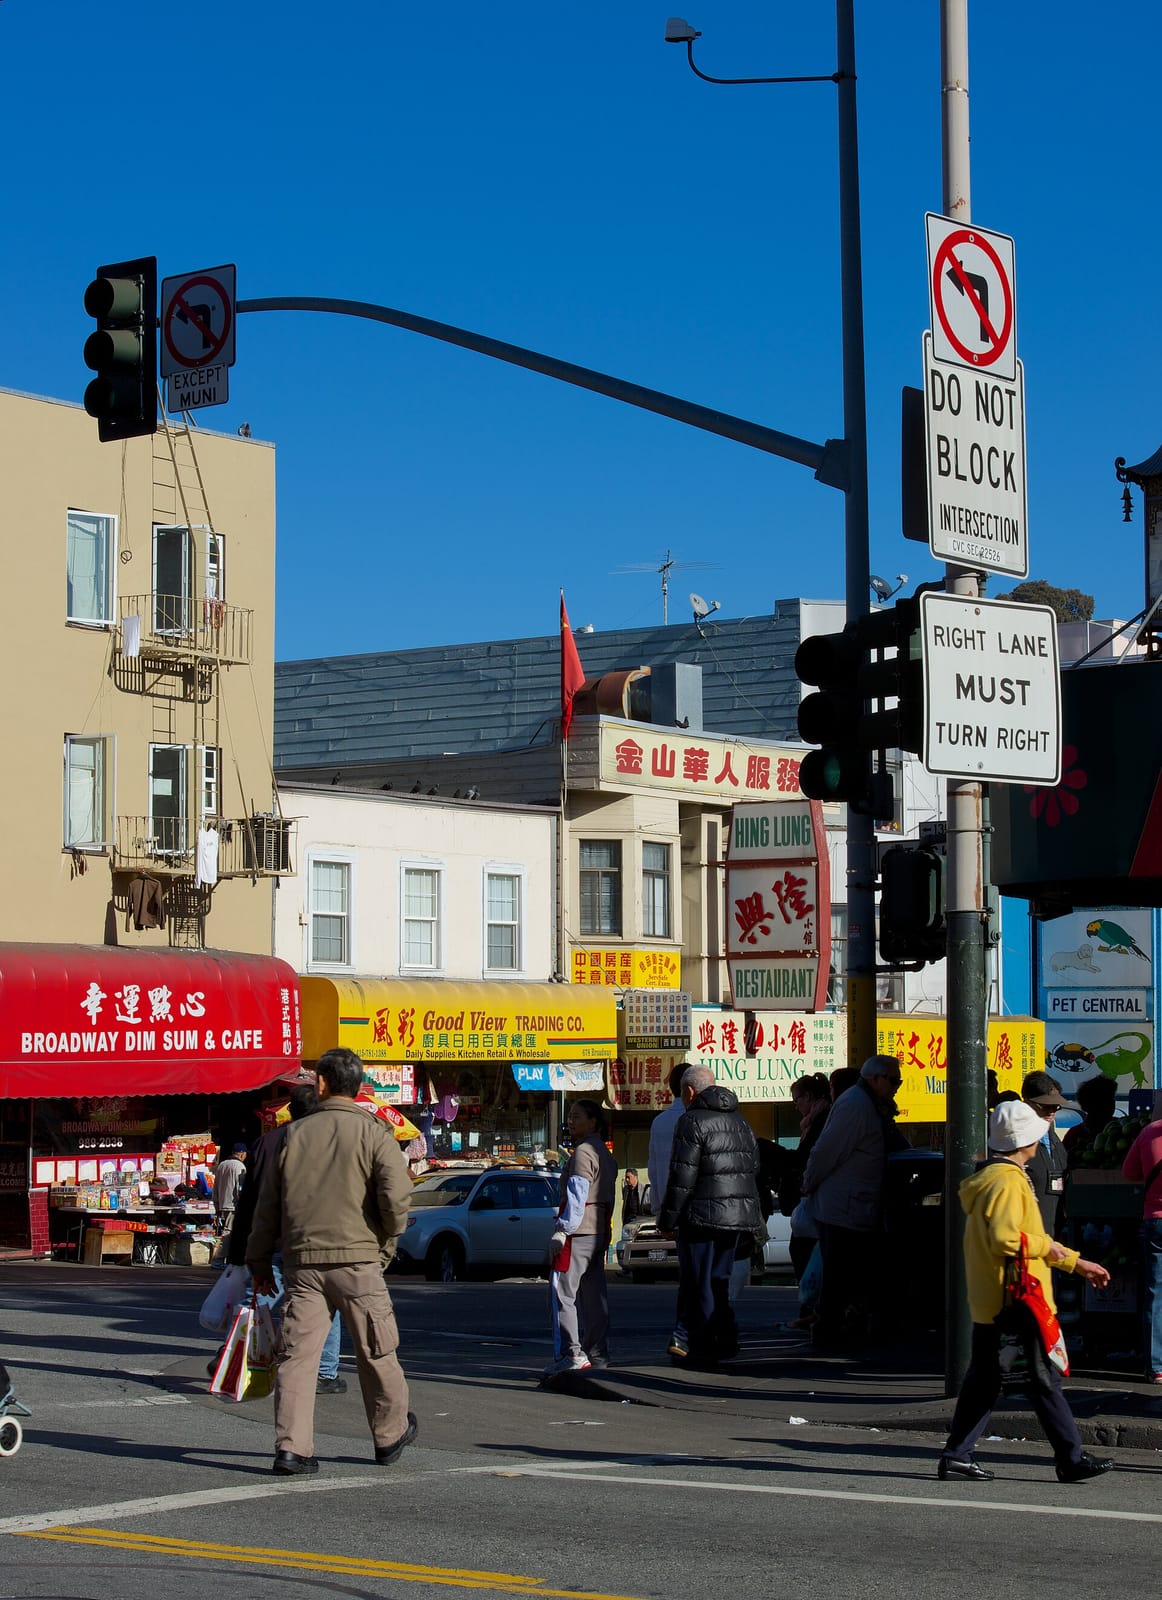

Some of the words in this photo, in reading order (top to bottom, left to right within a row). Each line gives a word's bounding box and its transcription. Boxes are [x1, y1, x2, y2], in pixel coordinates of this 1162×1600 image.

[173, 367, 222, 390] EXCEPT
[180, 387, 216, 408] MUNI
[931, 369, 962, 416] DO
[975, 380, 1016, 430] NOT
[936, 434, 1017, 493] BLOCK
[940, 503, 1019, 546] INTERSECTION
[952, 539, 965, 553] CVC
[933, 625, 986, 651] RIGHT
[998, 632, 1048, 657] LANE
[956, 673, 1031, 706] MUST
[935, 722, 987, 748] TURN
[997, 727, 1050, 753] RIGHT
[615, 738, 801, 793] 金山華人服務
[735, 817, 770, 848] HING
[774, 814, 811, 847] LUNG
[735, 968, 815, 998] RESTAURANT
[1052, 998, 1077, 1012] PET
[1082, 998, 1142, 1012] CENTRAL
[423, 1010, 465, 1031] Good
[470, 1011, 507, 1031] View
[515, 1015, 564, 1032] TRADING
[567, 1016, 585, 1032] CO.
[21, 1031, 119, 1053] BROADWAY
[125, 1030, 156, 1051] DIM
[162, 1029, 199, 1051] SUM
[204, 1029, 216, 1050] &
[221, 1029, 263, 1050] CAFE
[405, 1049, 424, 1060] Daily
[425, 1049, 456, 1060] Supplies
[458, 1049, 484, 1058] Kitchen
[486, 1049, 507, 1058] Retail
[508, 1049, 514, 1058] &
[516, 1049, 550, 1058] Wholesale
[518, 1067, 544, 1081] PLAY
[757, 1058, 805, 1081] LUNG
[61, 1121, 105, 1134] BROADWAY
